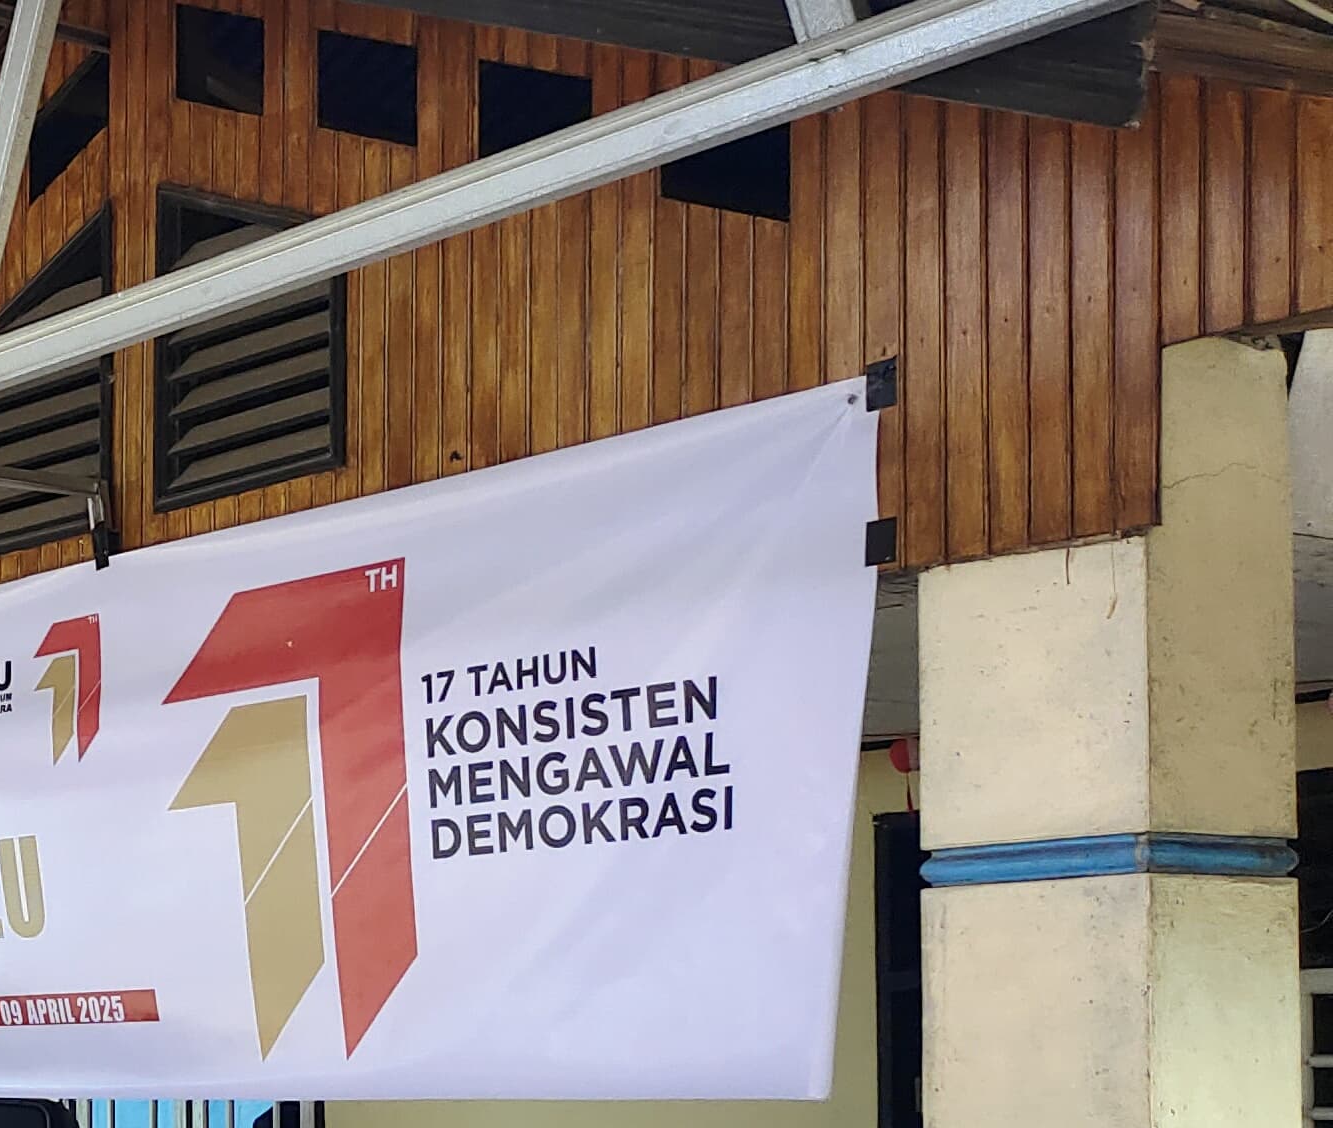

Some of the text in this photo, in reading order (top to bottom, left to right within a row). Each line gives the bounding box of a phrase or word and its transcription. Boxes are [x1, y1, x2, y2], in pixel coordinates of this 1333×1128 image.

[365, 564, 397, 592] TH
[421, 646, 597, 704] 17 TAHUN
[426, 676, 717, 758] KONSISTEN
[428, 732, 730, 808] MENGAWAL
[431, 786, 733, 859] DEMOKRASI
[0, 996, 125, 1025] 09 APRIL 2025
